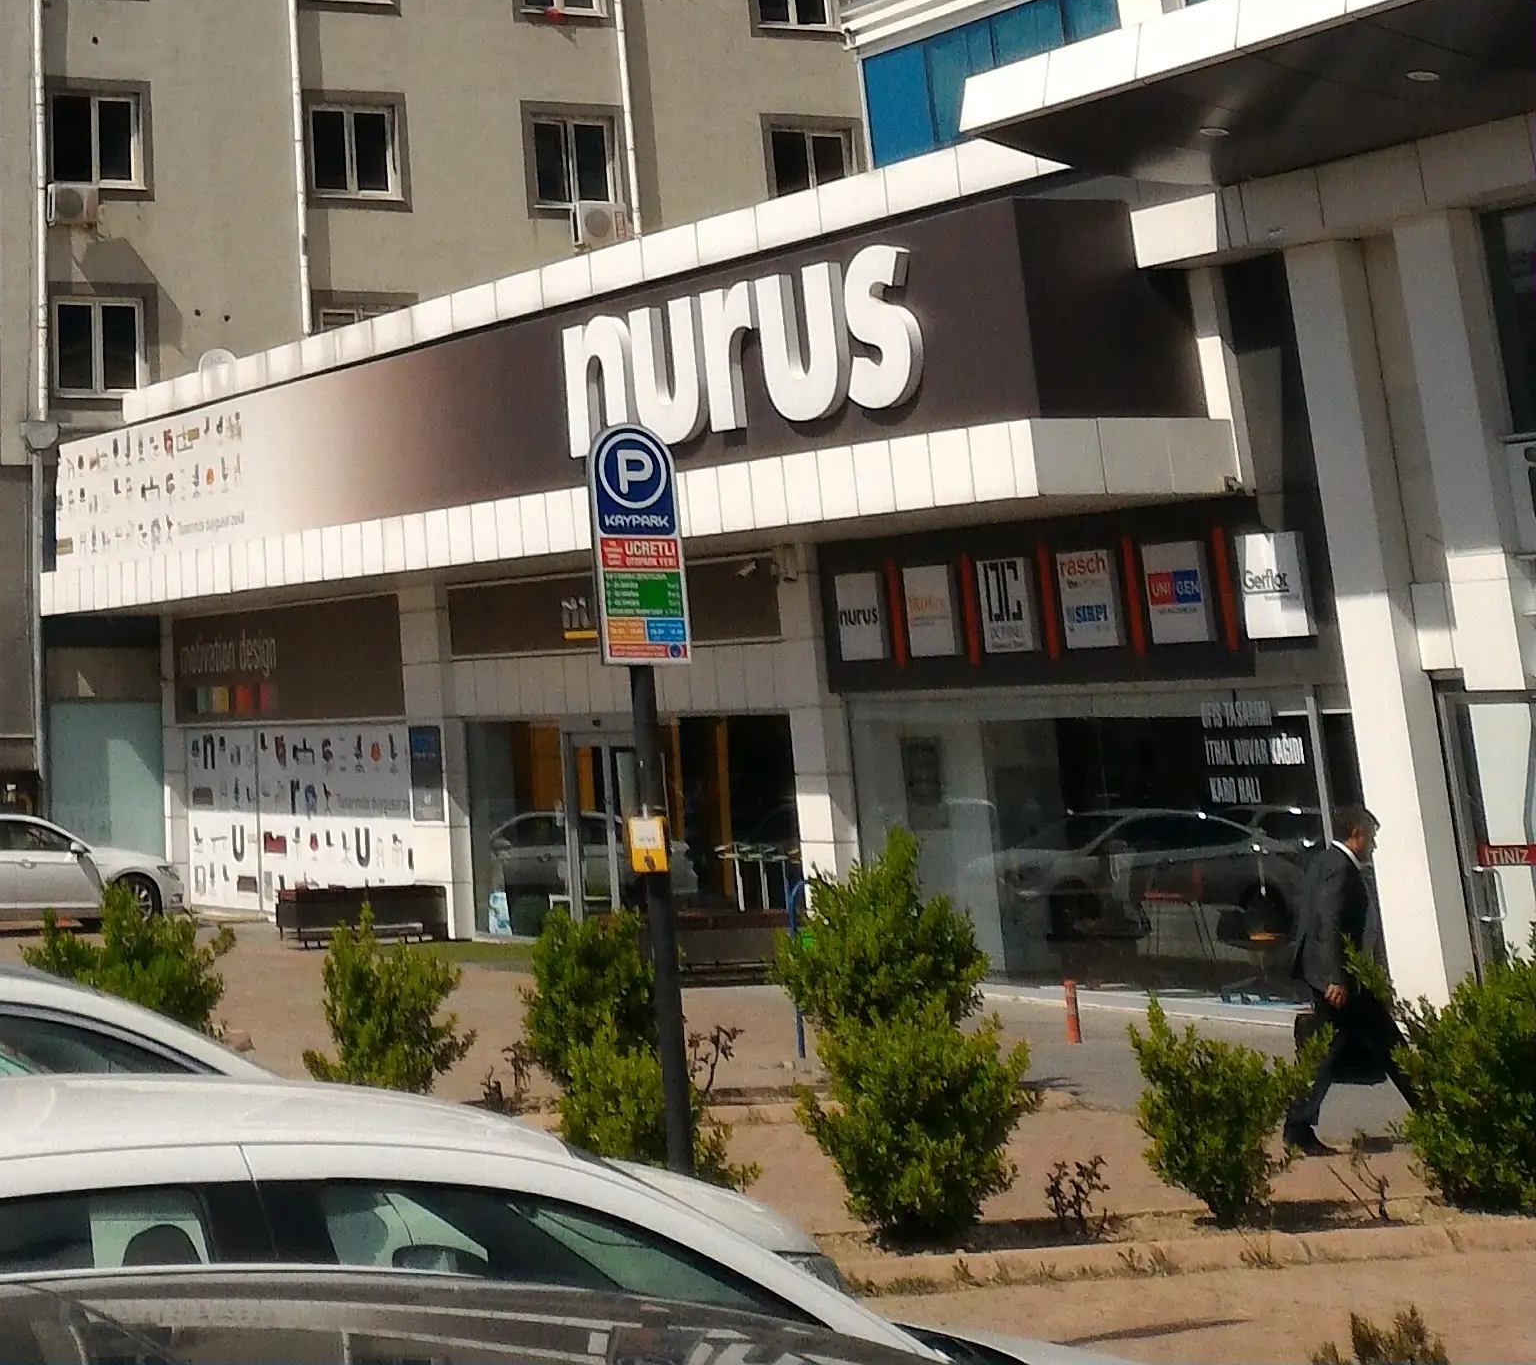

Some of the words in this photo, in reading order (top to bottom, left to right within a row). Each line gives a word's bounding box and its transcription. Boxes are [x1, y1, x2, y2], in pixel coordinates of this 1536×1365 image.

[562, 244, 923, 458] nurus
[617, 449, 654, 494] P
[604, 514, 670, 529] KAYPARK
[1059, 552, 1106, 577] rasch
[1242, 568, 1290, 591] Gerflor
[839, 609, 879, 626] nurus
[238, 628, 277, 677] design
